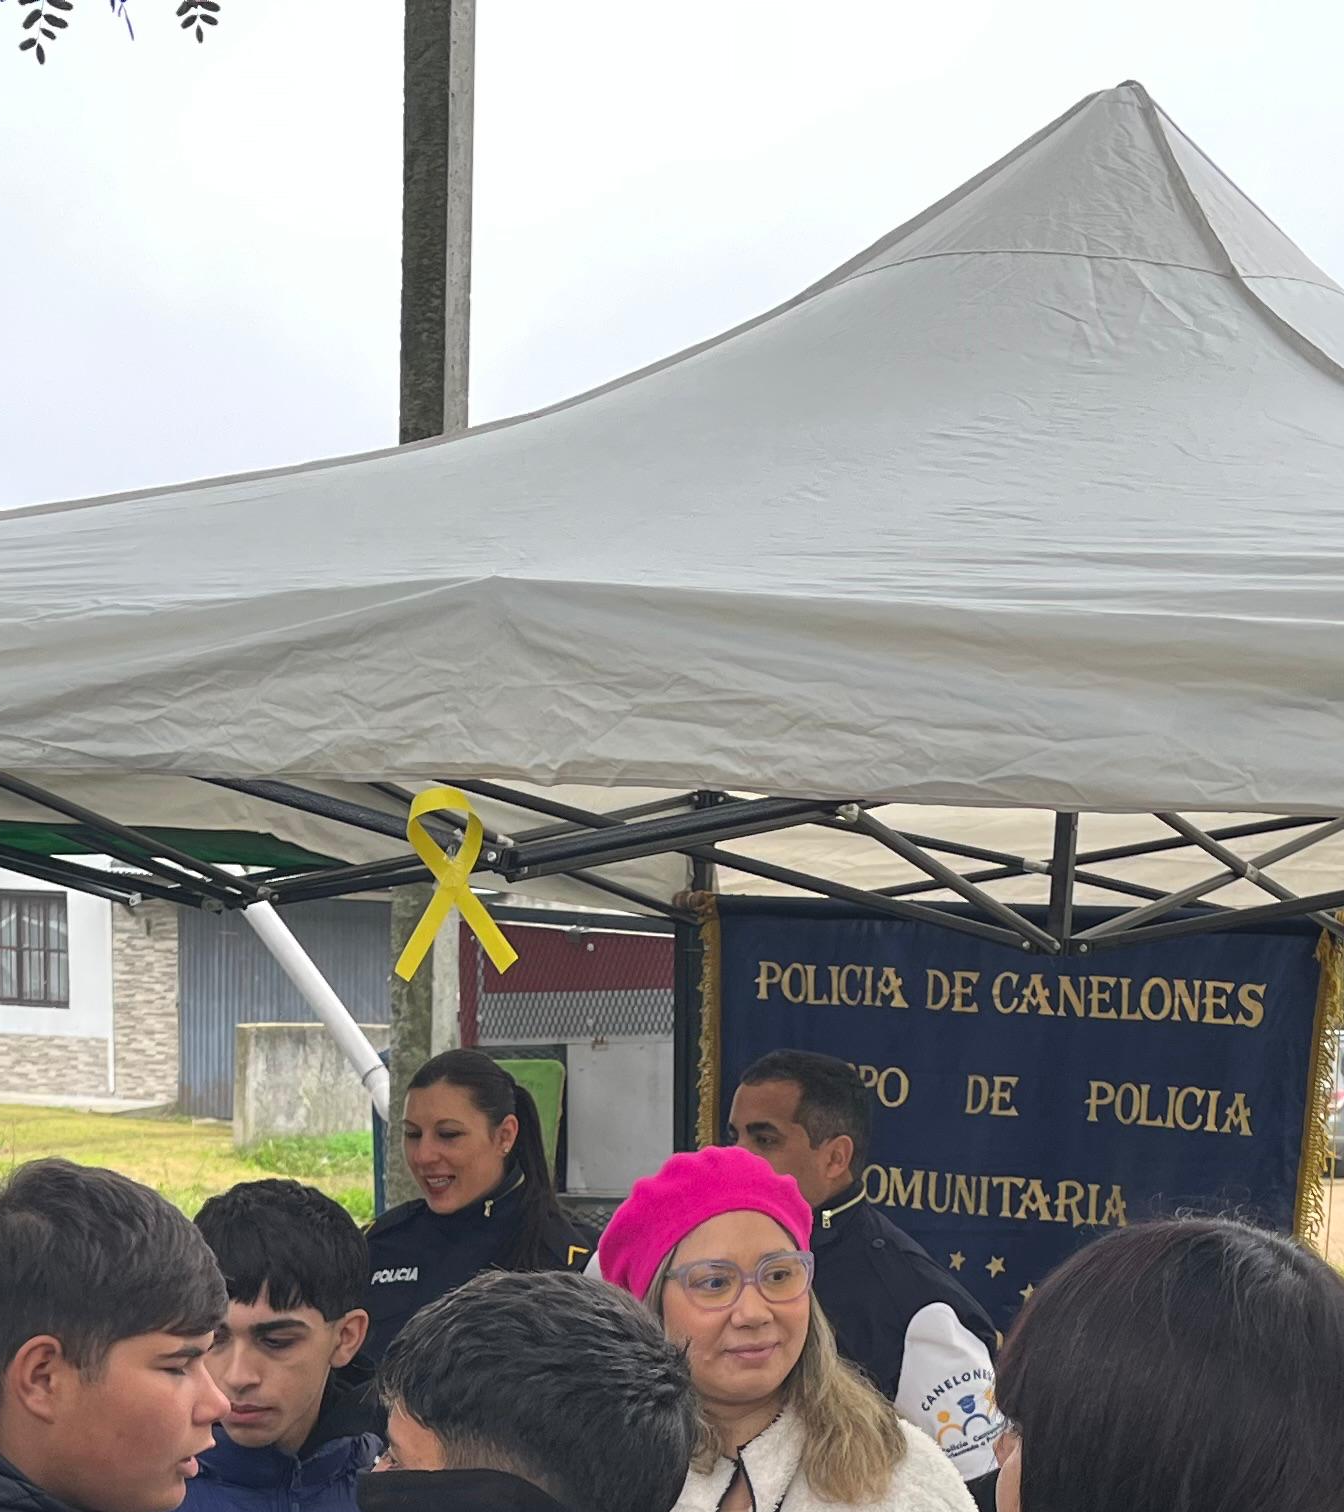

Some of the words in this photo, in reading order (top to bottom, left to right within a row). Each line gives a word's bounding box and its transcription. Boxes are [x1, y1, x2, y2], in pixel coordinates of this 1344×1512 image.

[754, 960, 909, 1008] POLICIA
[926, 969, 980, 1013] DE
[992, 971, 1267, 1028] CANELONES
[964, 1075, 1019, 1117] DE
[1085, 1080, 1254, 1136] POLICIA
[861, 1163, 1127, 1229] OMUNITARIA
[370, 1266, 419, 1285] POLICIA
